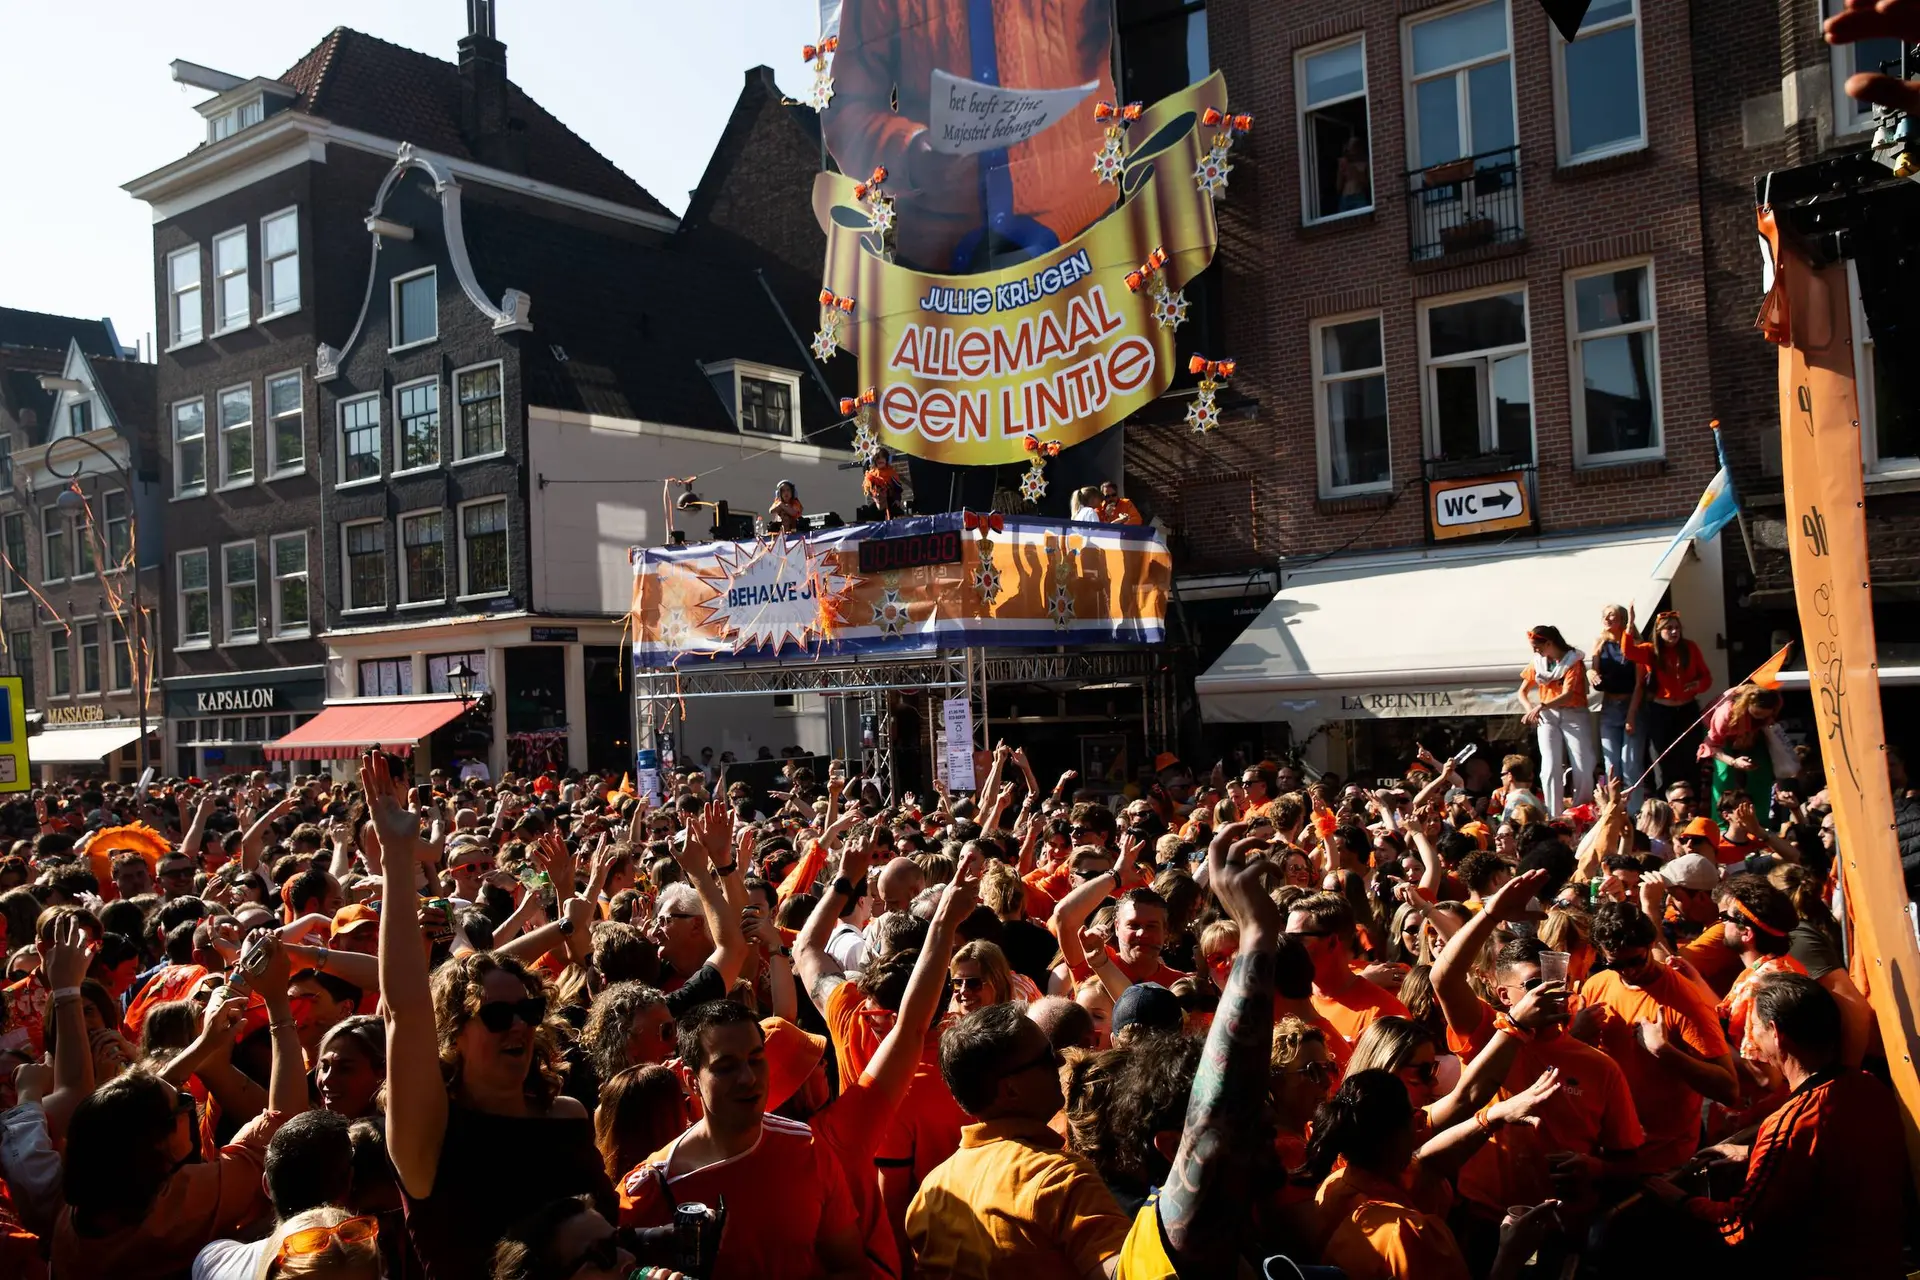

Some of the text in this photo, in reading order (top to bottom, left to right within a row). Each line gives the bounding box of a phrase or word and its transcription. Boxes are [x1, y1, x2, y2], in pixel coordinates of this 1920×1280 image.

[949, 84, 1044, 120] het heeft zijne
[943, 112, 1047, 148] Majesteit behaagd
[996, 249, 1092, 312] KRIJGEN
[1444, 494, 1477, 517] WC
[728, 581, 798, 608] BEHALVE
[197, 688, 274, 711] KAPSALON
[1341, 691, 1453, 710] LA REINITA
